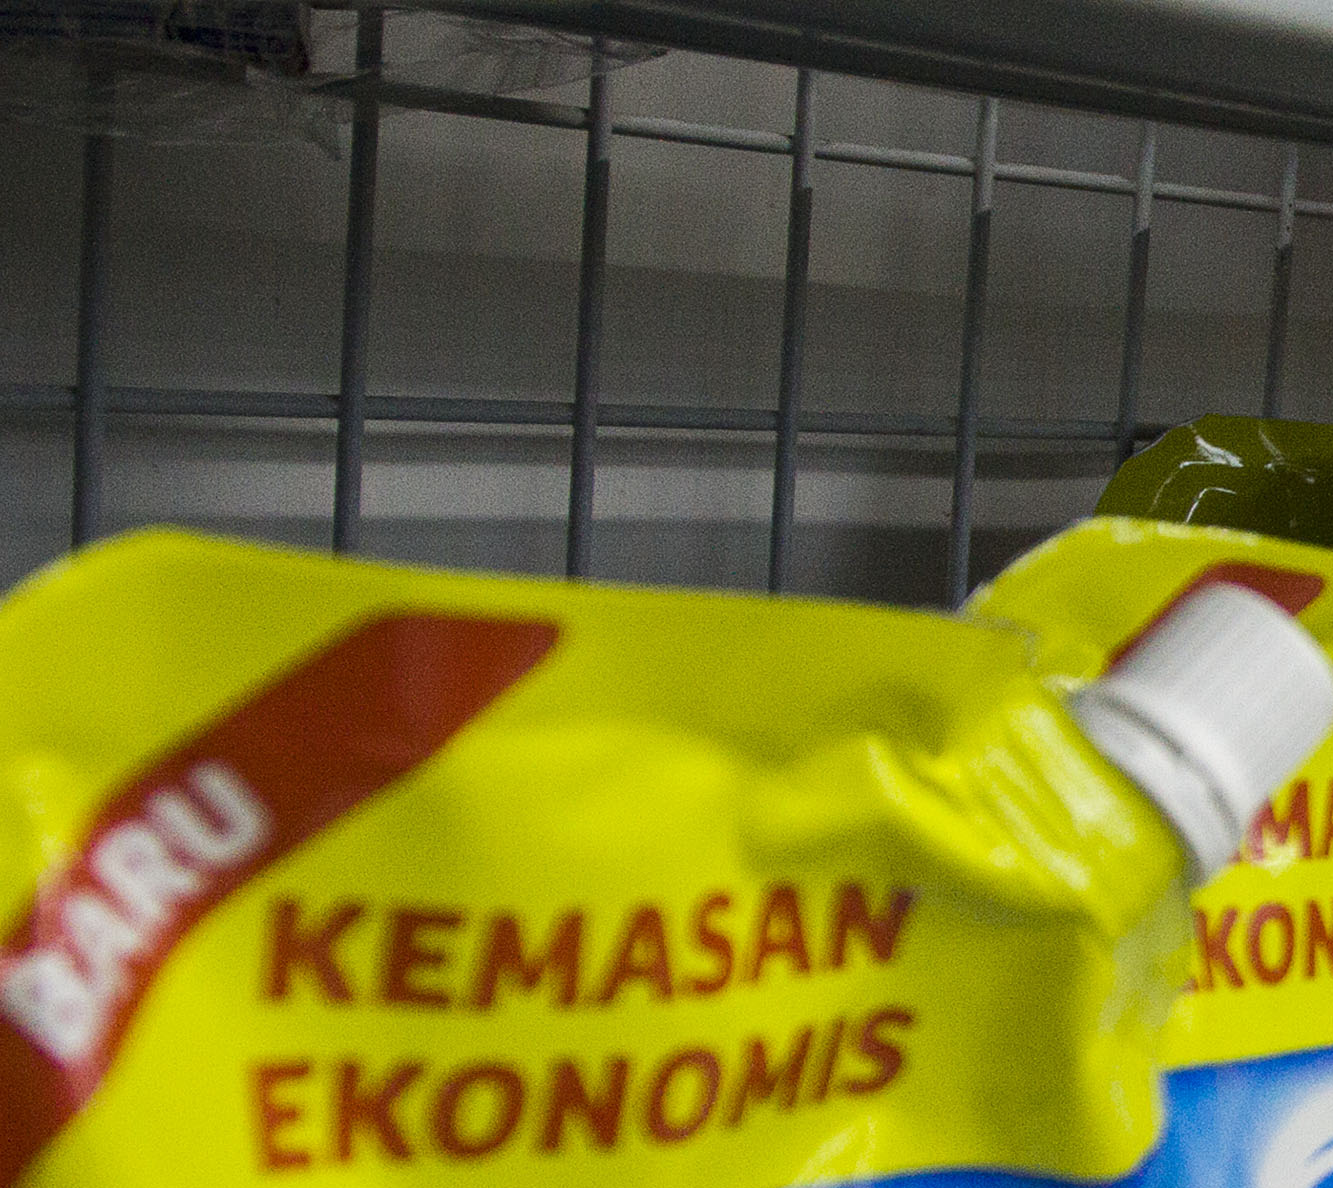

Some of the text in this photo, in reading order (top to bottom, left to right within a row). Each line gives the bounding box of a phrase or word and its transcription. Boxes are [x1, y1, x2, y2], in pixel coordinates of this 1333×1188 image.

[4, 760, 270, 1062] BARU
[266, 880, 912, 1010] KEMASAN
[250, 1004, 915, 1175] EKONOMIS
